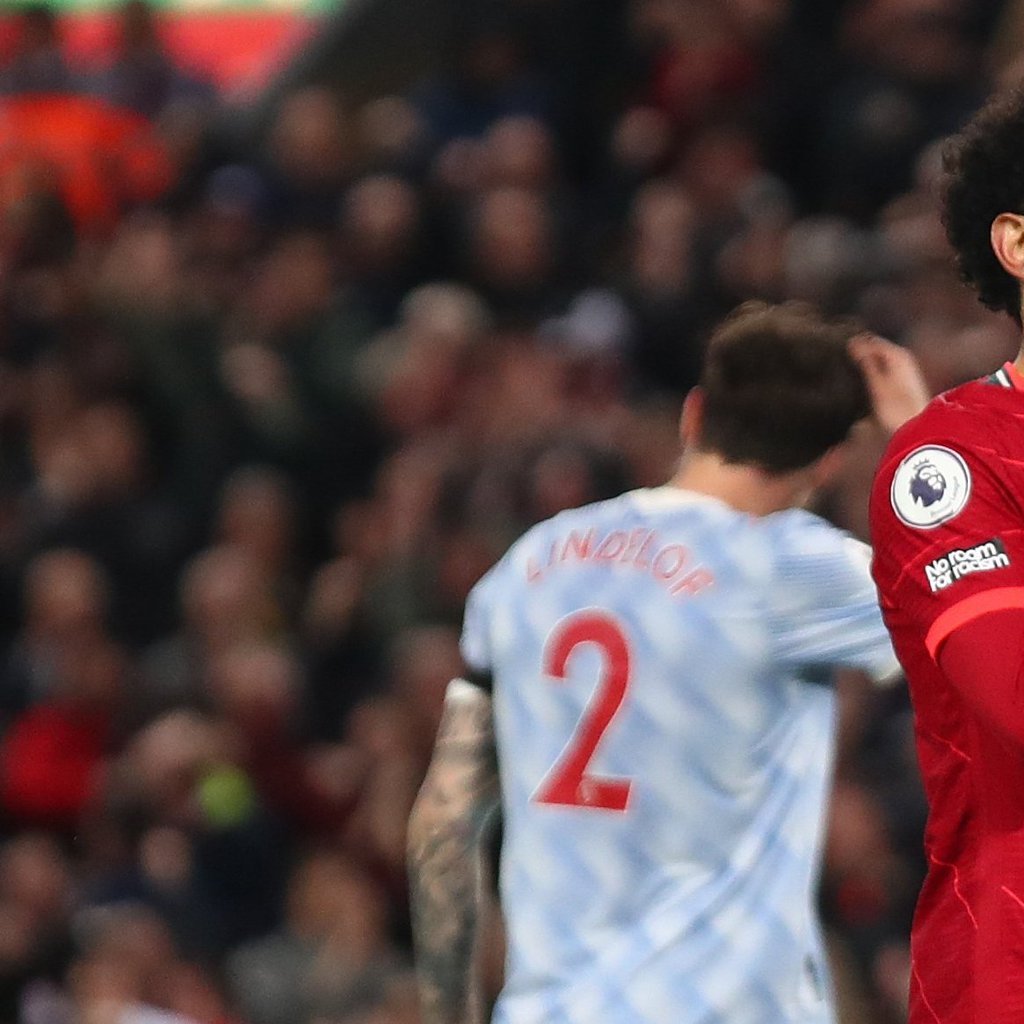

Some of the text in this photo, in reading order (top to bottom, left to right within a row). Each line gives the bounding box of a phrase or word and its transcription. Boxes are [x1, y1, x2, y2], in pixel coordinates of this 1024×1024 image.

[526, 527, 715, 597] LINDELOF
[925, 543, 997, 577] No room
[928, 553, 1010, 592] for racism
[529, 607, 632, 813] 2
